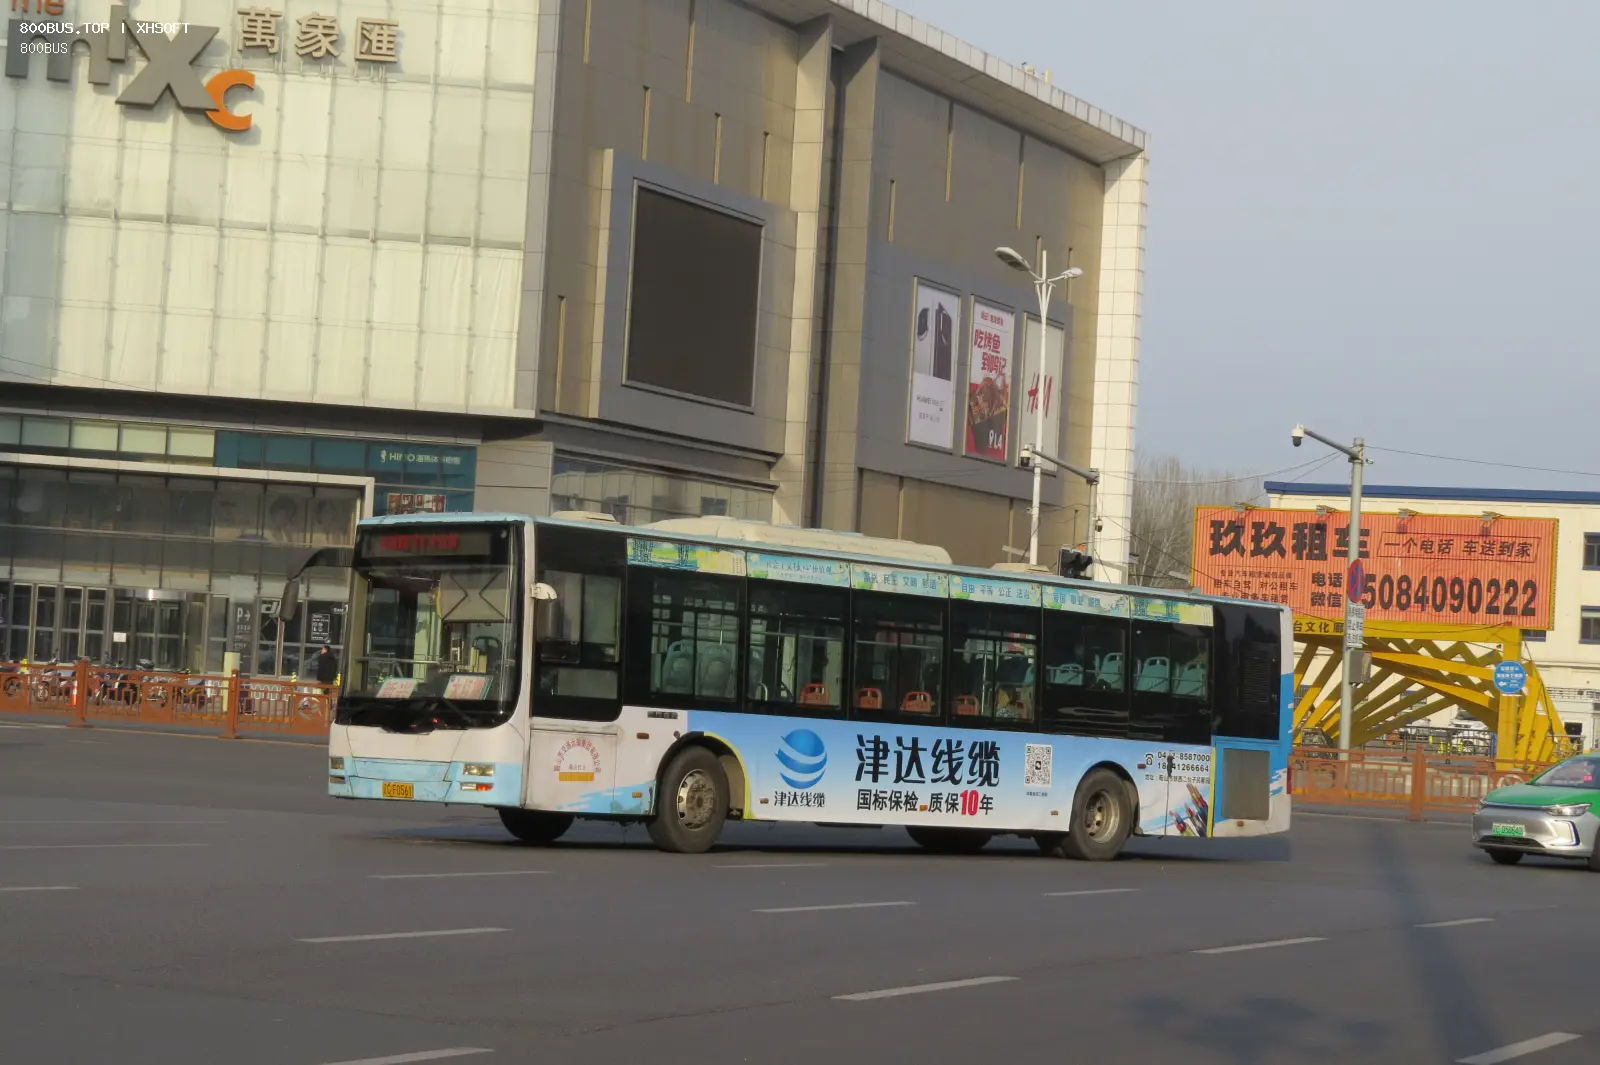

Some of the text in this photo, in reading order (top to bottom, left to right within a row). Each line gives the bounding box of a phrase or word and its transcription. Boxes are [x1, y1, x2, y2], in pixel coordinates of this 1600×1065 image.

[238, 7, 399, 62] 萬象匯
[974, 329, 1001, 354] 吃烤鱼
[1209, 519, 1370, 561] 玖玖租车
[1384, 538, 1533, 559] 一个电话 车送到家
[961, 582, 1030, 600] 自由 平等 公正 法治
[1260, 581, 1299, 592] 对公租车
[1311, 571, 1538, 617] 电话 5084090222
[1311, 591, 1342, 608] 微信
[855, 733, 1001, 787] 津达线缆
[1157, 751, 1210, 762] 042-8587000
[1157, 762, 1210, 773] 1841266664
[773, 790, 826, 808] 津达线缆
[856, 788, 994, 816] 国标保检 质保10年
